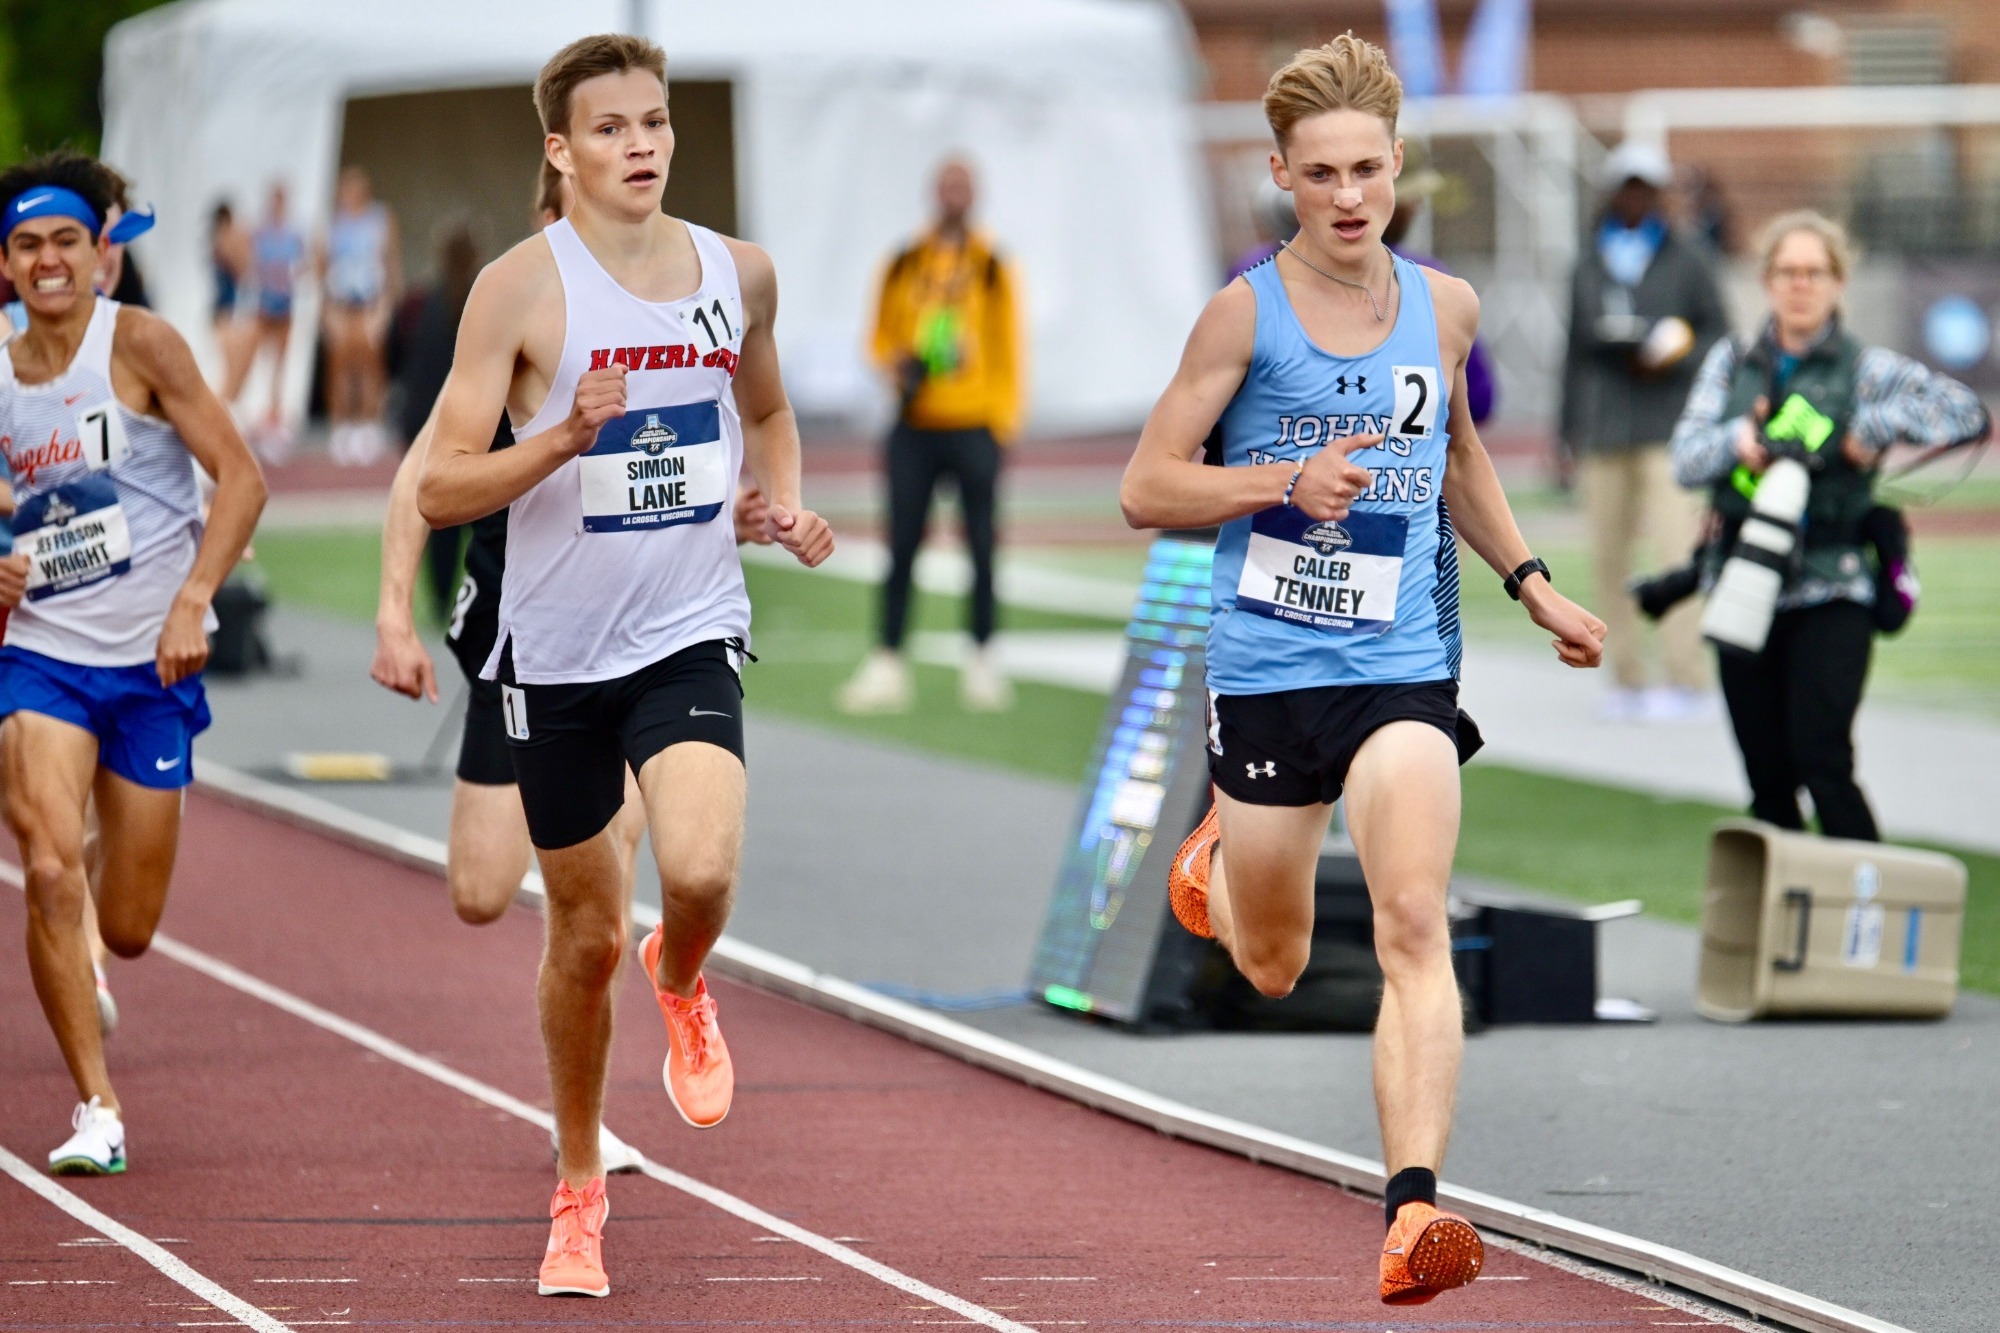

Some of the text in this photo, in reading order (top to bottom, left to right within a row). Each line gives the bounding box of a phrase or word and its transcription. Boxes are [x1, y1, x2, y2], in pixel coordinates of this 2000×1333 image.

[692, 298, 733, 348] 11
[1400, 373, 1428, 436] 2
[85, 411, 110, 462] 7
[626, 456, 686, 481] SIMON
[628, 481, 687, 512] LANE
[622, 509, 695, 526] LA CROSSE, WISCONSIN
[34, 520, 106, 557] JEFFERSON
[1303, 533, 1351, 546] CHAMPIONSHIPS
[40, 542, 110, 581] WRIGHT
[1293, 554, 1351, 581] CALEB
[1273, 575, 1366, 616] TENNEY
[1274, 607, 1354, 629] LA CROSSE, WISCONSIN
